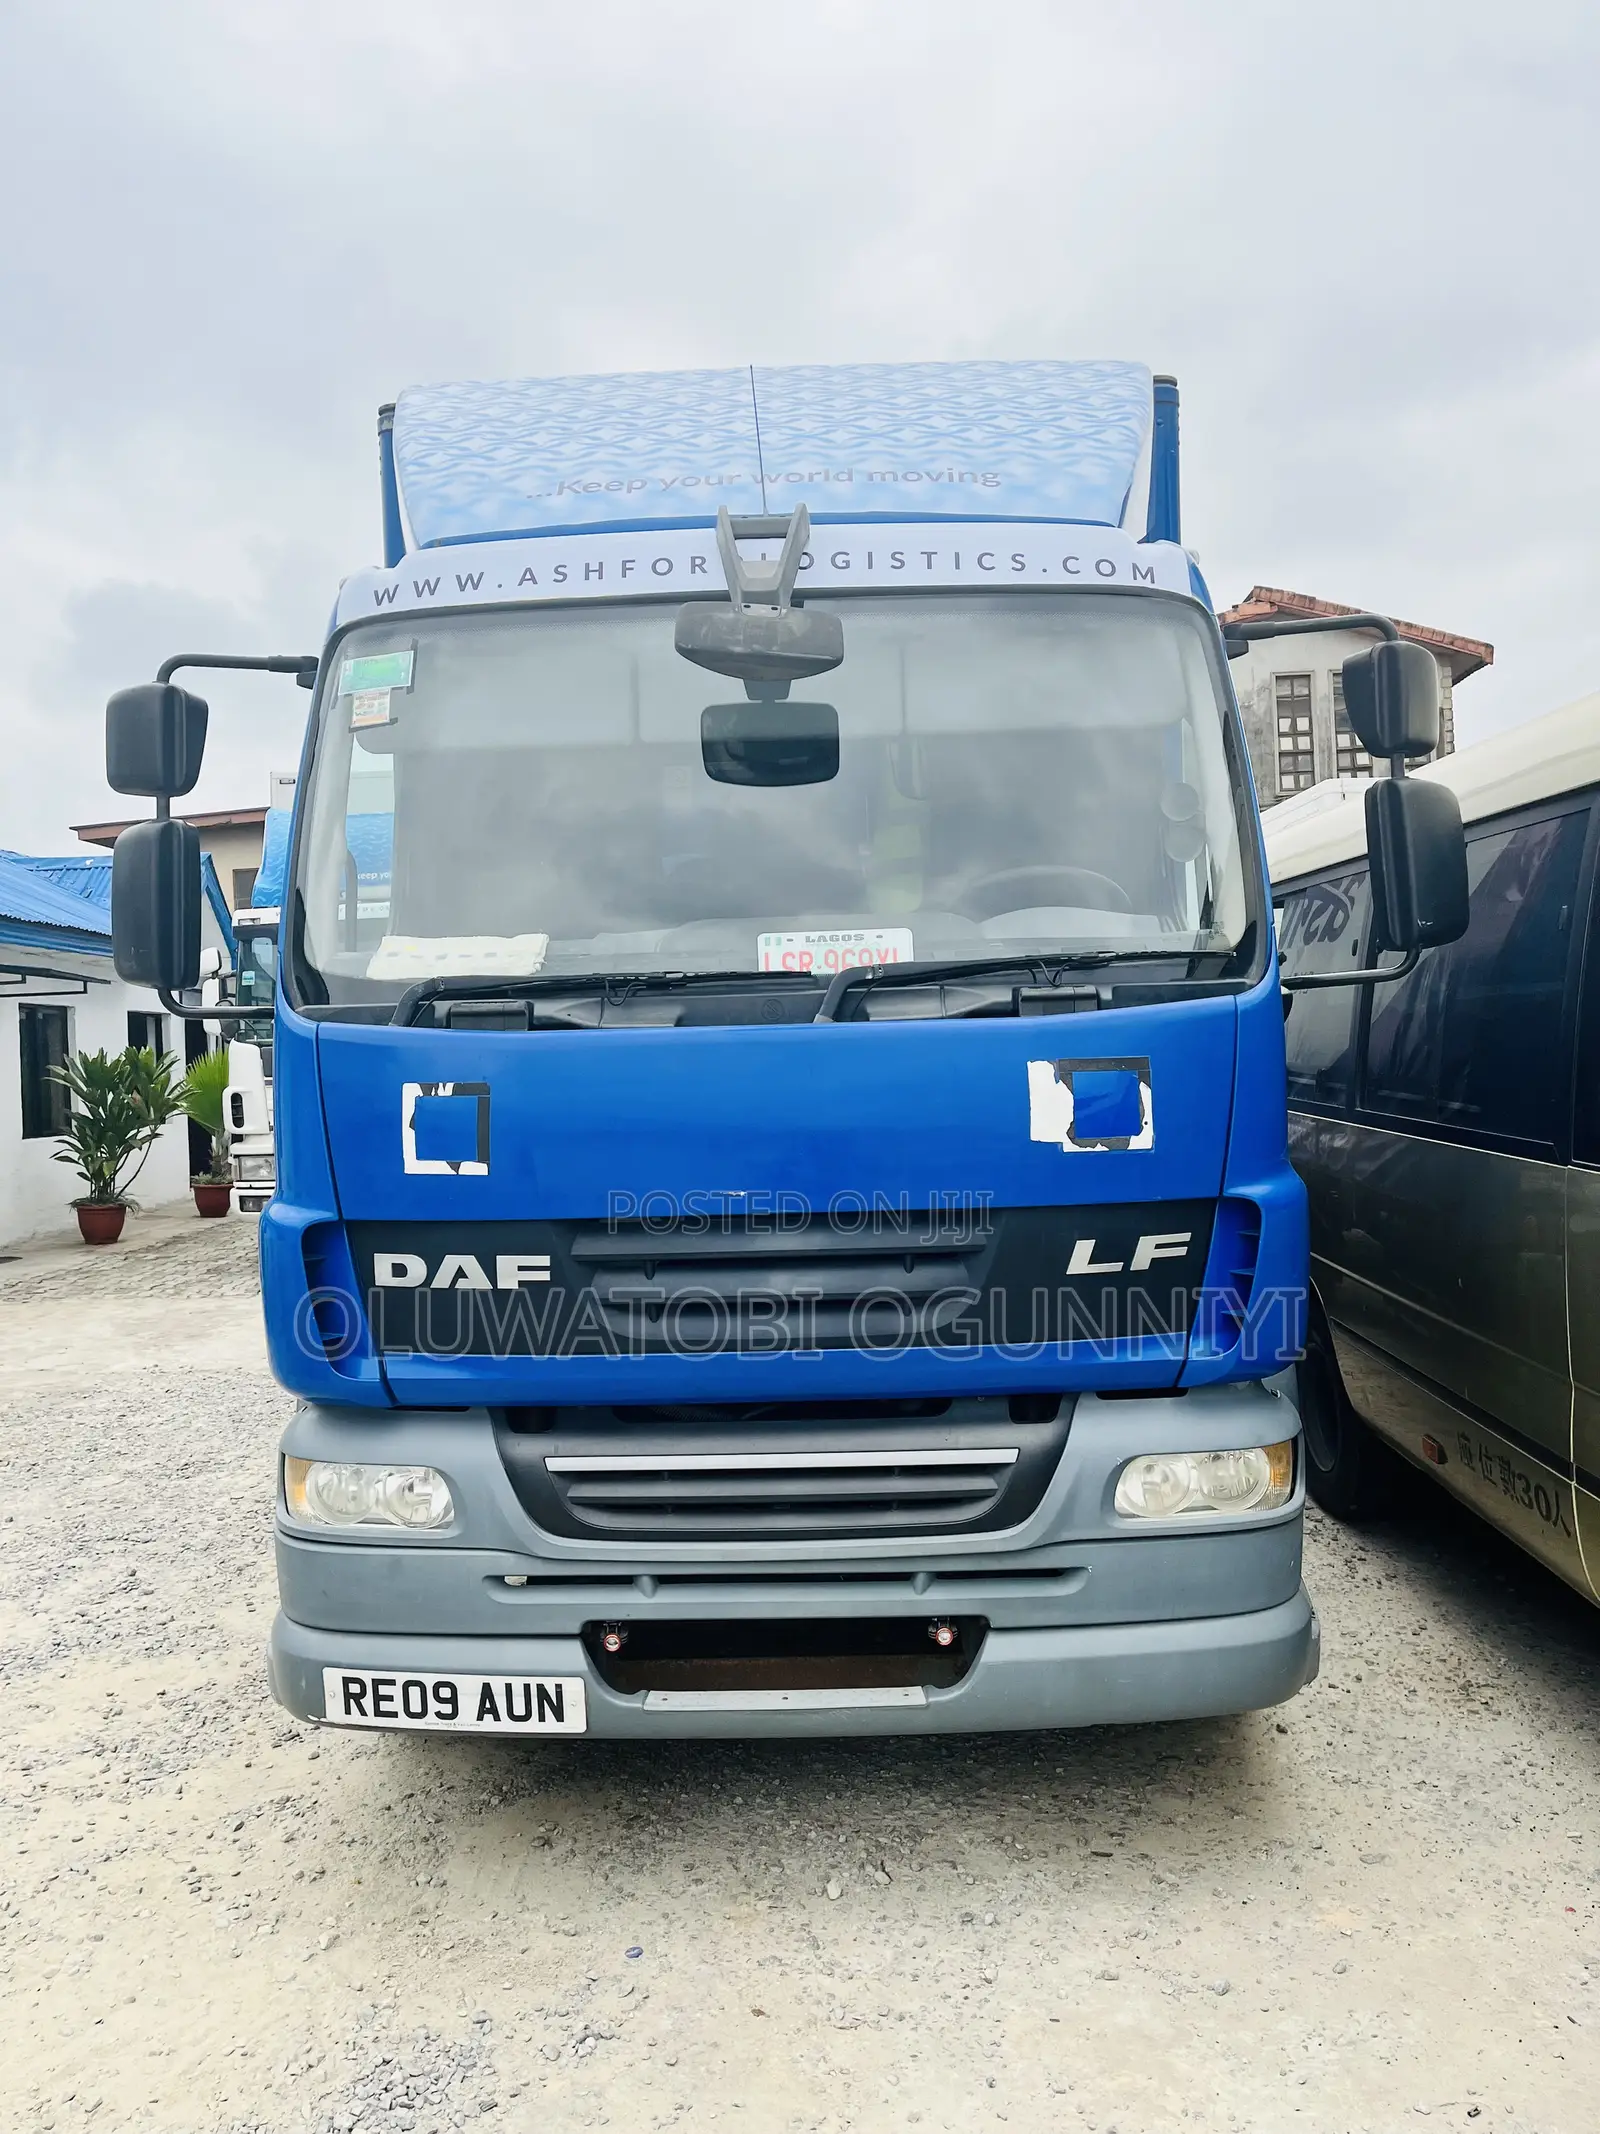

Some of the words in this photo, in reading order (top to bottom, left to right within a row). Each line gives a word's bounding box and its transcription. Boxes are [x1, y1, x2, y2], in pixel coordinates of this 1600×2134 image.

[659, 472, 742, 492] your
[750, 467, 854, 484] world
[867, 467, 1002, 488] moving
[372, 550, 1157, 606] WWW.ASHFOROGISTICS.COM
[805, 933, 865, 943] LAGOS
[374, 1253, 551, 1290] DAF
[1066, 1232, 1191, 1274] LF
[341, 1676, 459, 1720] RE09
[476, 1682, 564, 1722] AUN
